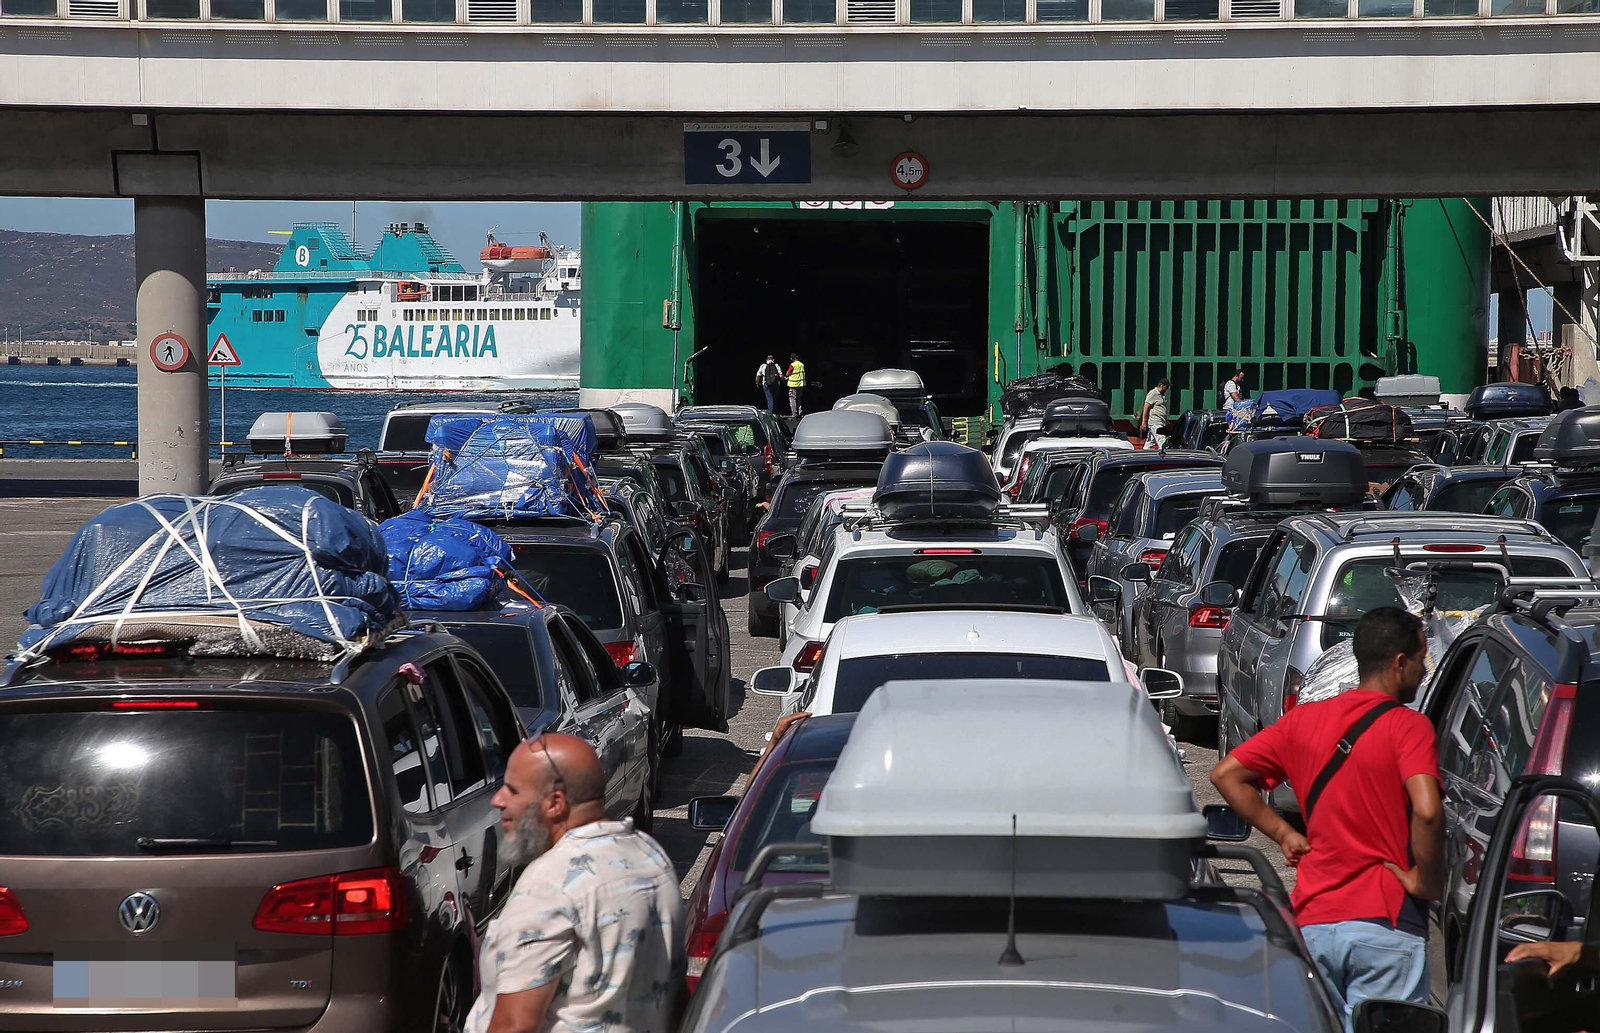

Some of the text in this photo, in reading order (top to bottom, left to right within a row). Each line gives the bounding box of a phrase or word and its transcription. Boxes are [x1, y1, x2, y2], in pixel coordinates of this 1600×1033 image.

[716, 138, 742, 177] 3
[897, 164, 923, 177] 4,5m
[344, 323, 368, 360] 25
[344, 361, 369, 372] AÑOS
